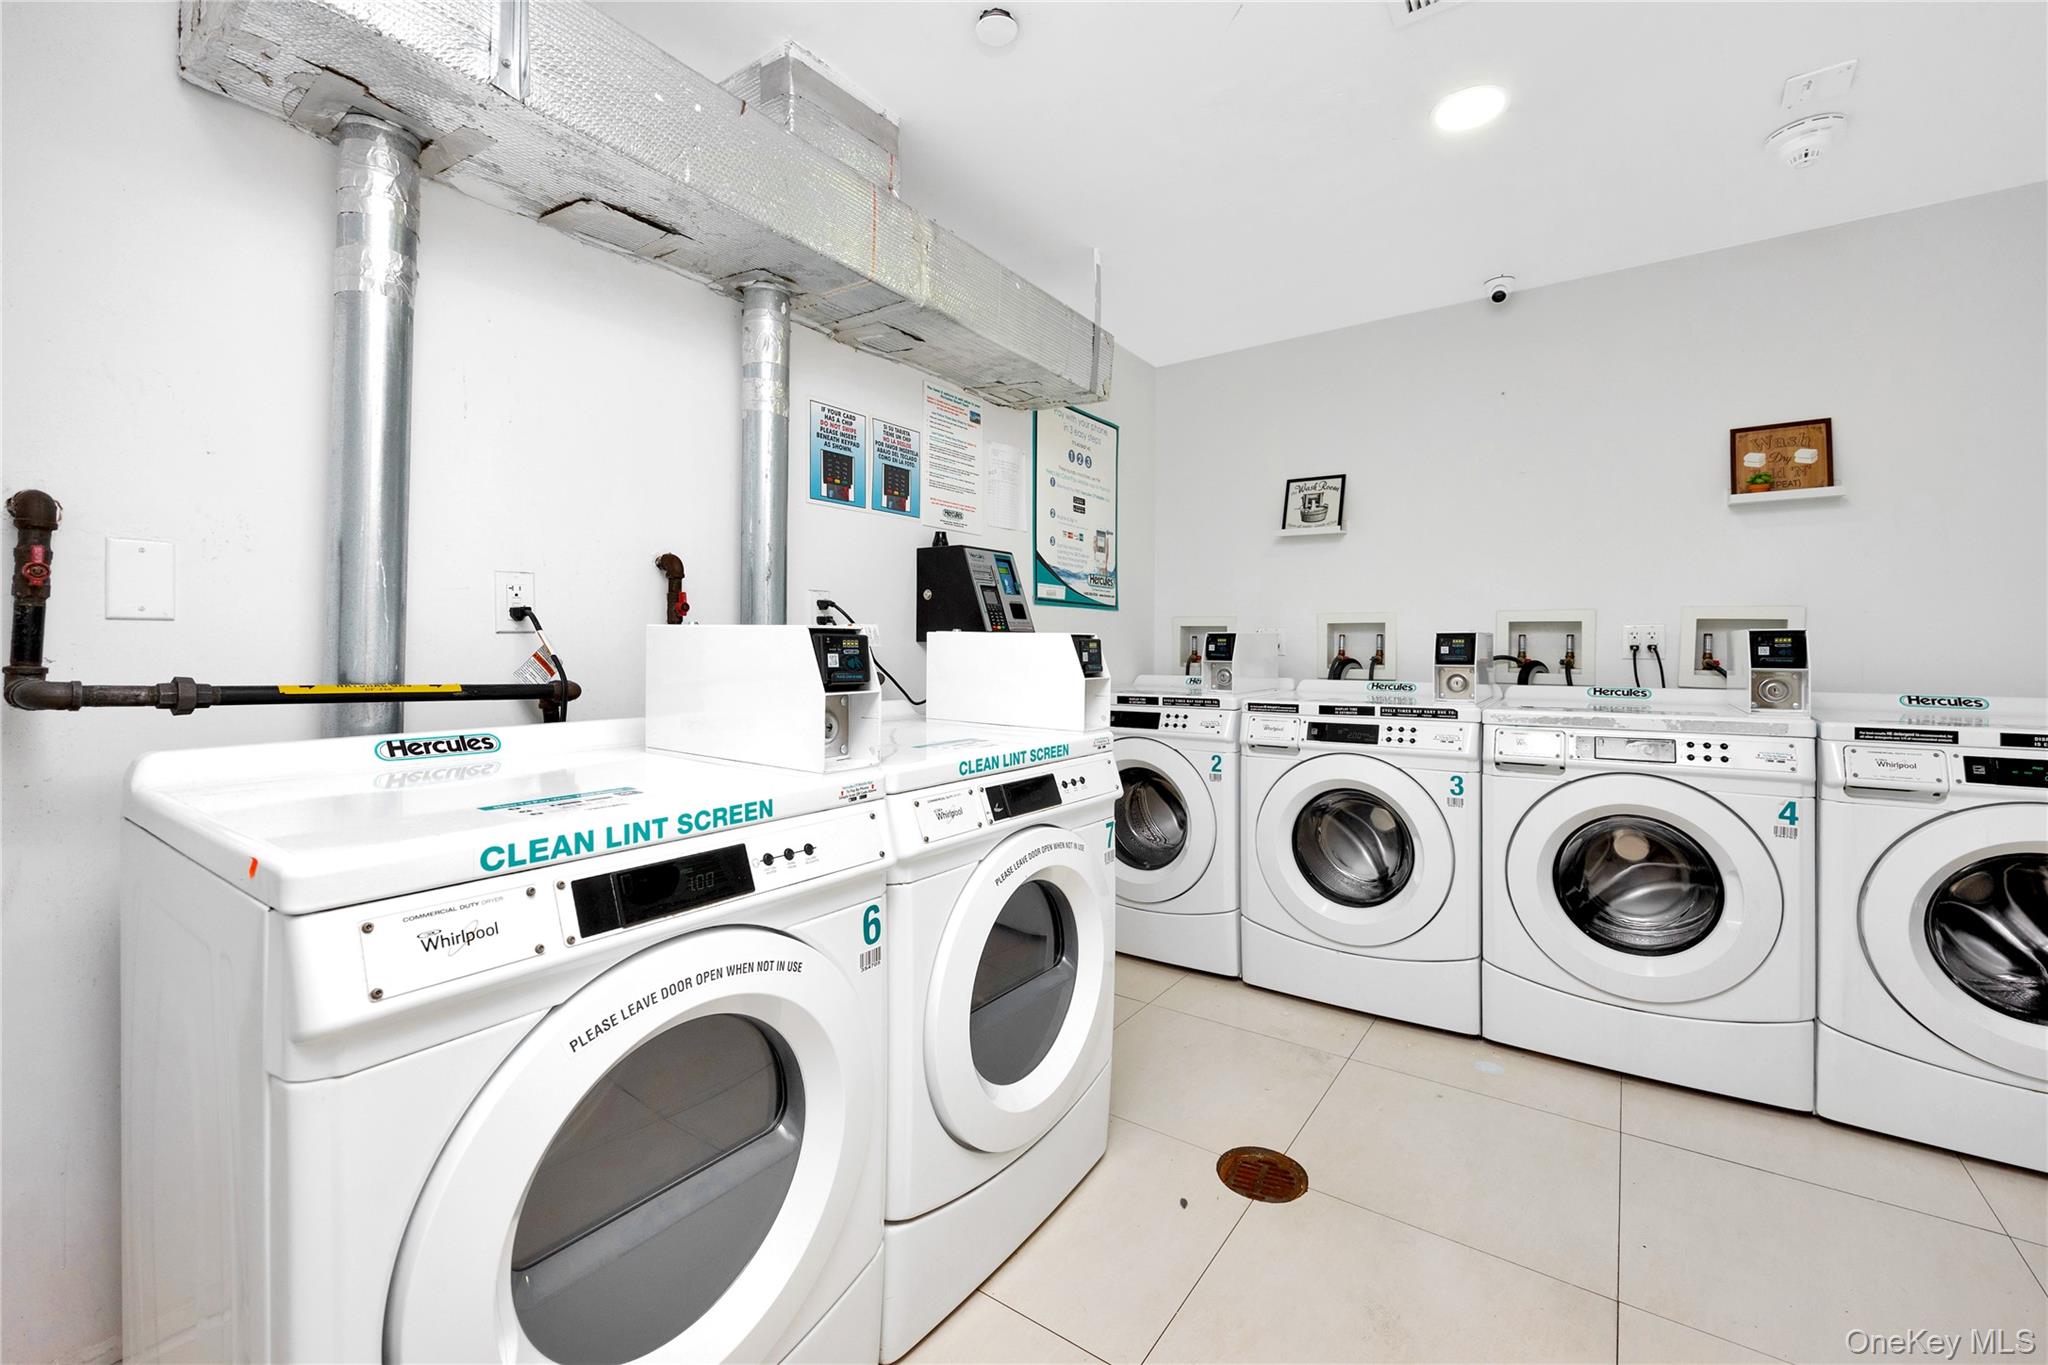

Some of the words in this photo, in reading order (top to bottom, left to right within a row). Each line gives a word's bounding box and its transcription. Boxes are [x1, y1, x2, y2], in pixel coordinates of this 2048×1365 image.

[827, 408, 841, 417] YOUR
[843, 412, 856, 421] CARD
[820, 426, 838, 436] PLEASE
[840, 432, 856, 440] INSERT
[842, 426, 856, 434] SWIPE
[816, 432, 840, 442] BENEATH
[841, 439, 860, 448] KEYPAD
[1752, 432, 1811, 451] Wash
[1769, 451, 1792, 464] Dry
[1295, 482, 1318, 493] Wash
[1318, 481, 1339, 492] Room
[1090, 574, 1113, 586] Hercules
[1371, 682, 1413, 691] Hercules
[1593, 688, 1647, 697] Hercules
[1907, 695, 1983, 708] Hercules
[386, 735, 494, 757] Hercules
[959, 755, 1000, 776] CLEAN
[1003, 750, 1027, 767] LINT
[1030, 744, 1069, 762] SCREEN
[1211, 755, 1221, 772] 2
[1876, 761, 1917, 769] Whirlpool
[1450, 776, 1464, 796] 3
[936, 807, 963, 820] Whirlpool
[1778, 801, 1799, 826] 4
[480, 830, 594, 872] CLEAN
[606, 817, 668, 849] LINT
[677, 799, 774, 835] SCREEN
[1106, 821, 1114, 848] 7
[995, 867, 1014, 886] PLEASE
[1013, 856, 1028, 871] LEAVE
[1028, 848, 1041, 861] DOOR
[1042, 844, 1053, 854] OPEN
[1054, 842, 1065, 850] WHEN
[402, 906, 457, 923] COMMERCIAL
[460, 901, 479, 910] DUTY
[481, 896, 504, 905] DRYER
[863, 905, 881, 945] 6
[421, 922, 499, 952] Whirlpool
[569, 1014, 620, 1053] PLEASE
[621, 991, 659, 1020] LEAVE
[661, 977, 693, 1000] DOOR
[696, 967, 724, 985] OPEN
[726, 962, 755, 977] WHEN
[756, 960, 775, 972] NOT
[776, 960, 785, 971] IN
[787, 961, 802, 973] USE
